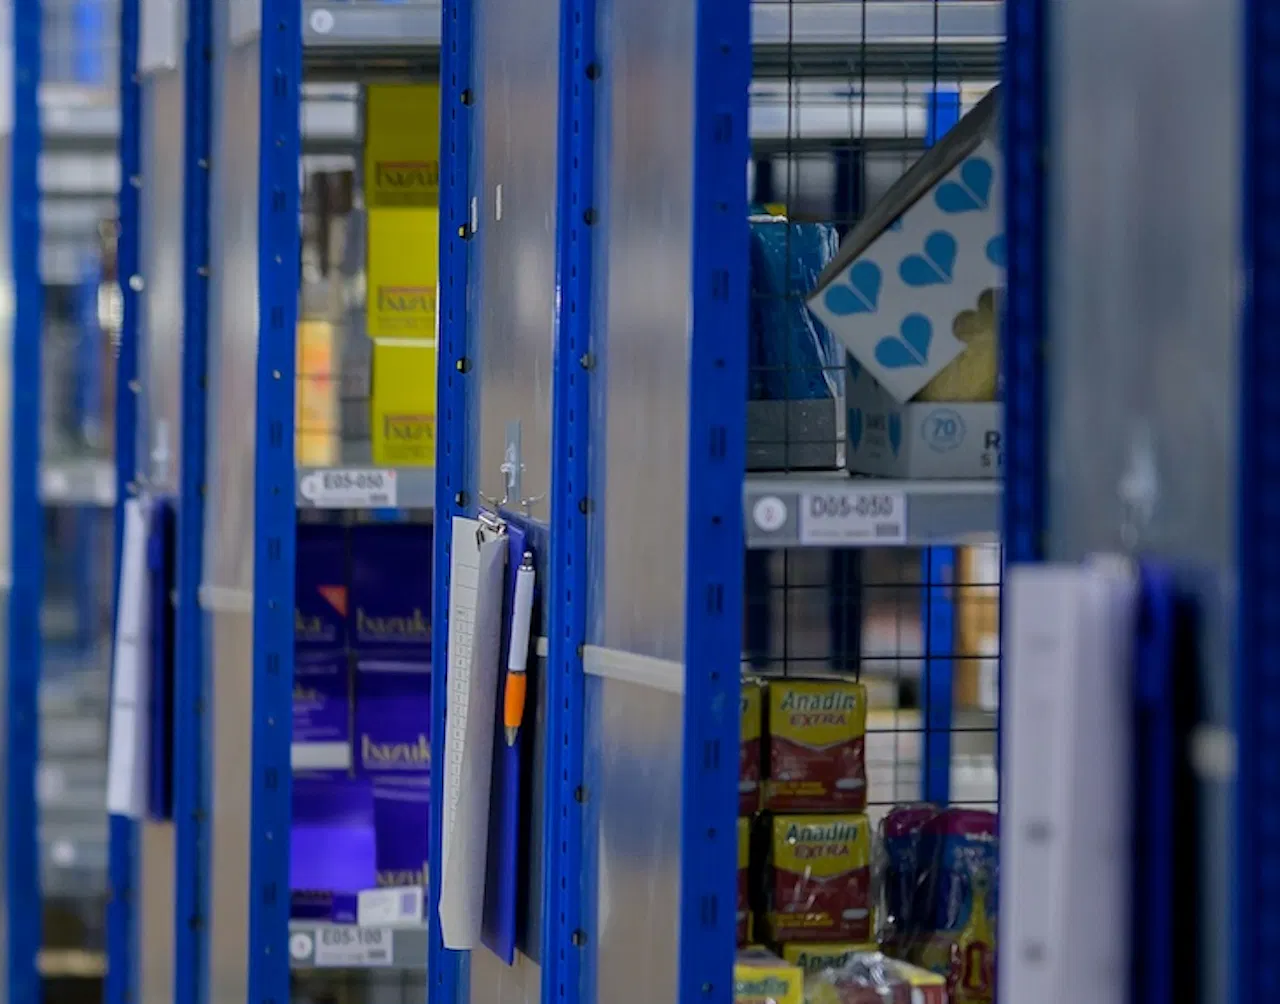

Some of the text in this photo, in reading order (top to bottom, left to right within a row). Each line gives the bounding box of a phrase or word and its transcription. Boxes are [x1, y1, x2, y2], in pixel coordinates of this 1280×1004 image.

[324, 472, 383, 490] E05-050
[809, 494, 894, 518] D05-050
[356, 606, 430, 634] bazuk
[781, 690, 855, 712] Anadin
[790, 713, 847, 727] EXTRA
[361, 733, 431, 761] bazuk
[786, 822, 858, 842] Anadin
[794, 844, 849, 859] EXTRA
[323, 927, 382, 945] E05-100
[796, 951, 849, 971] Anad
